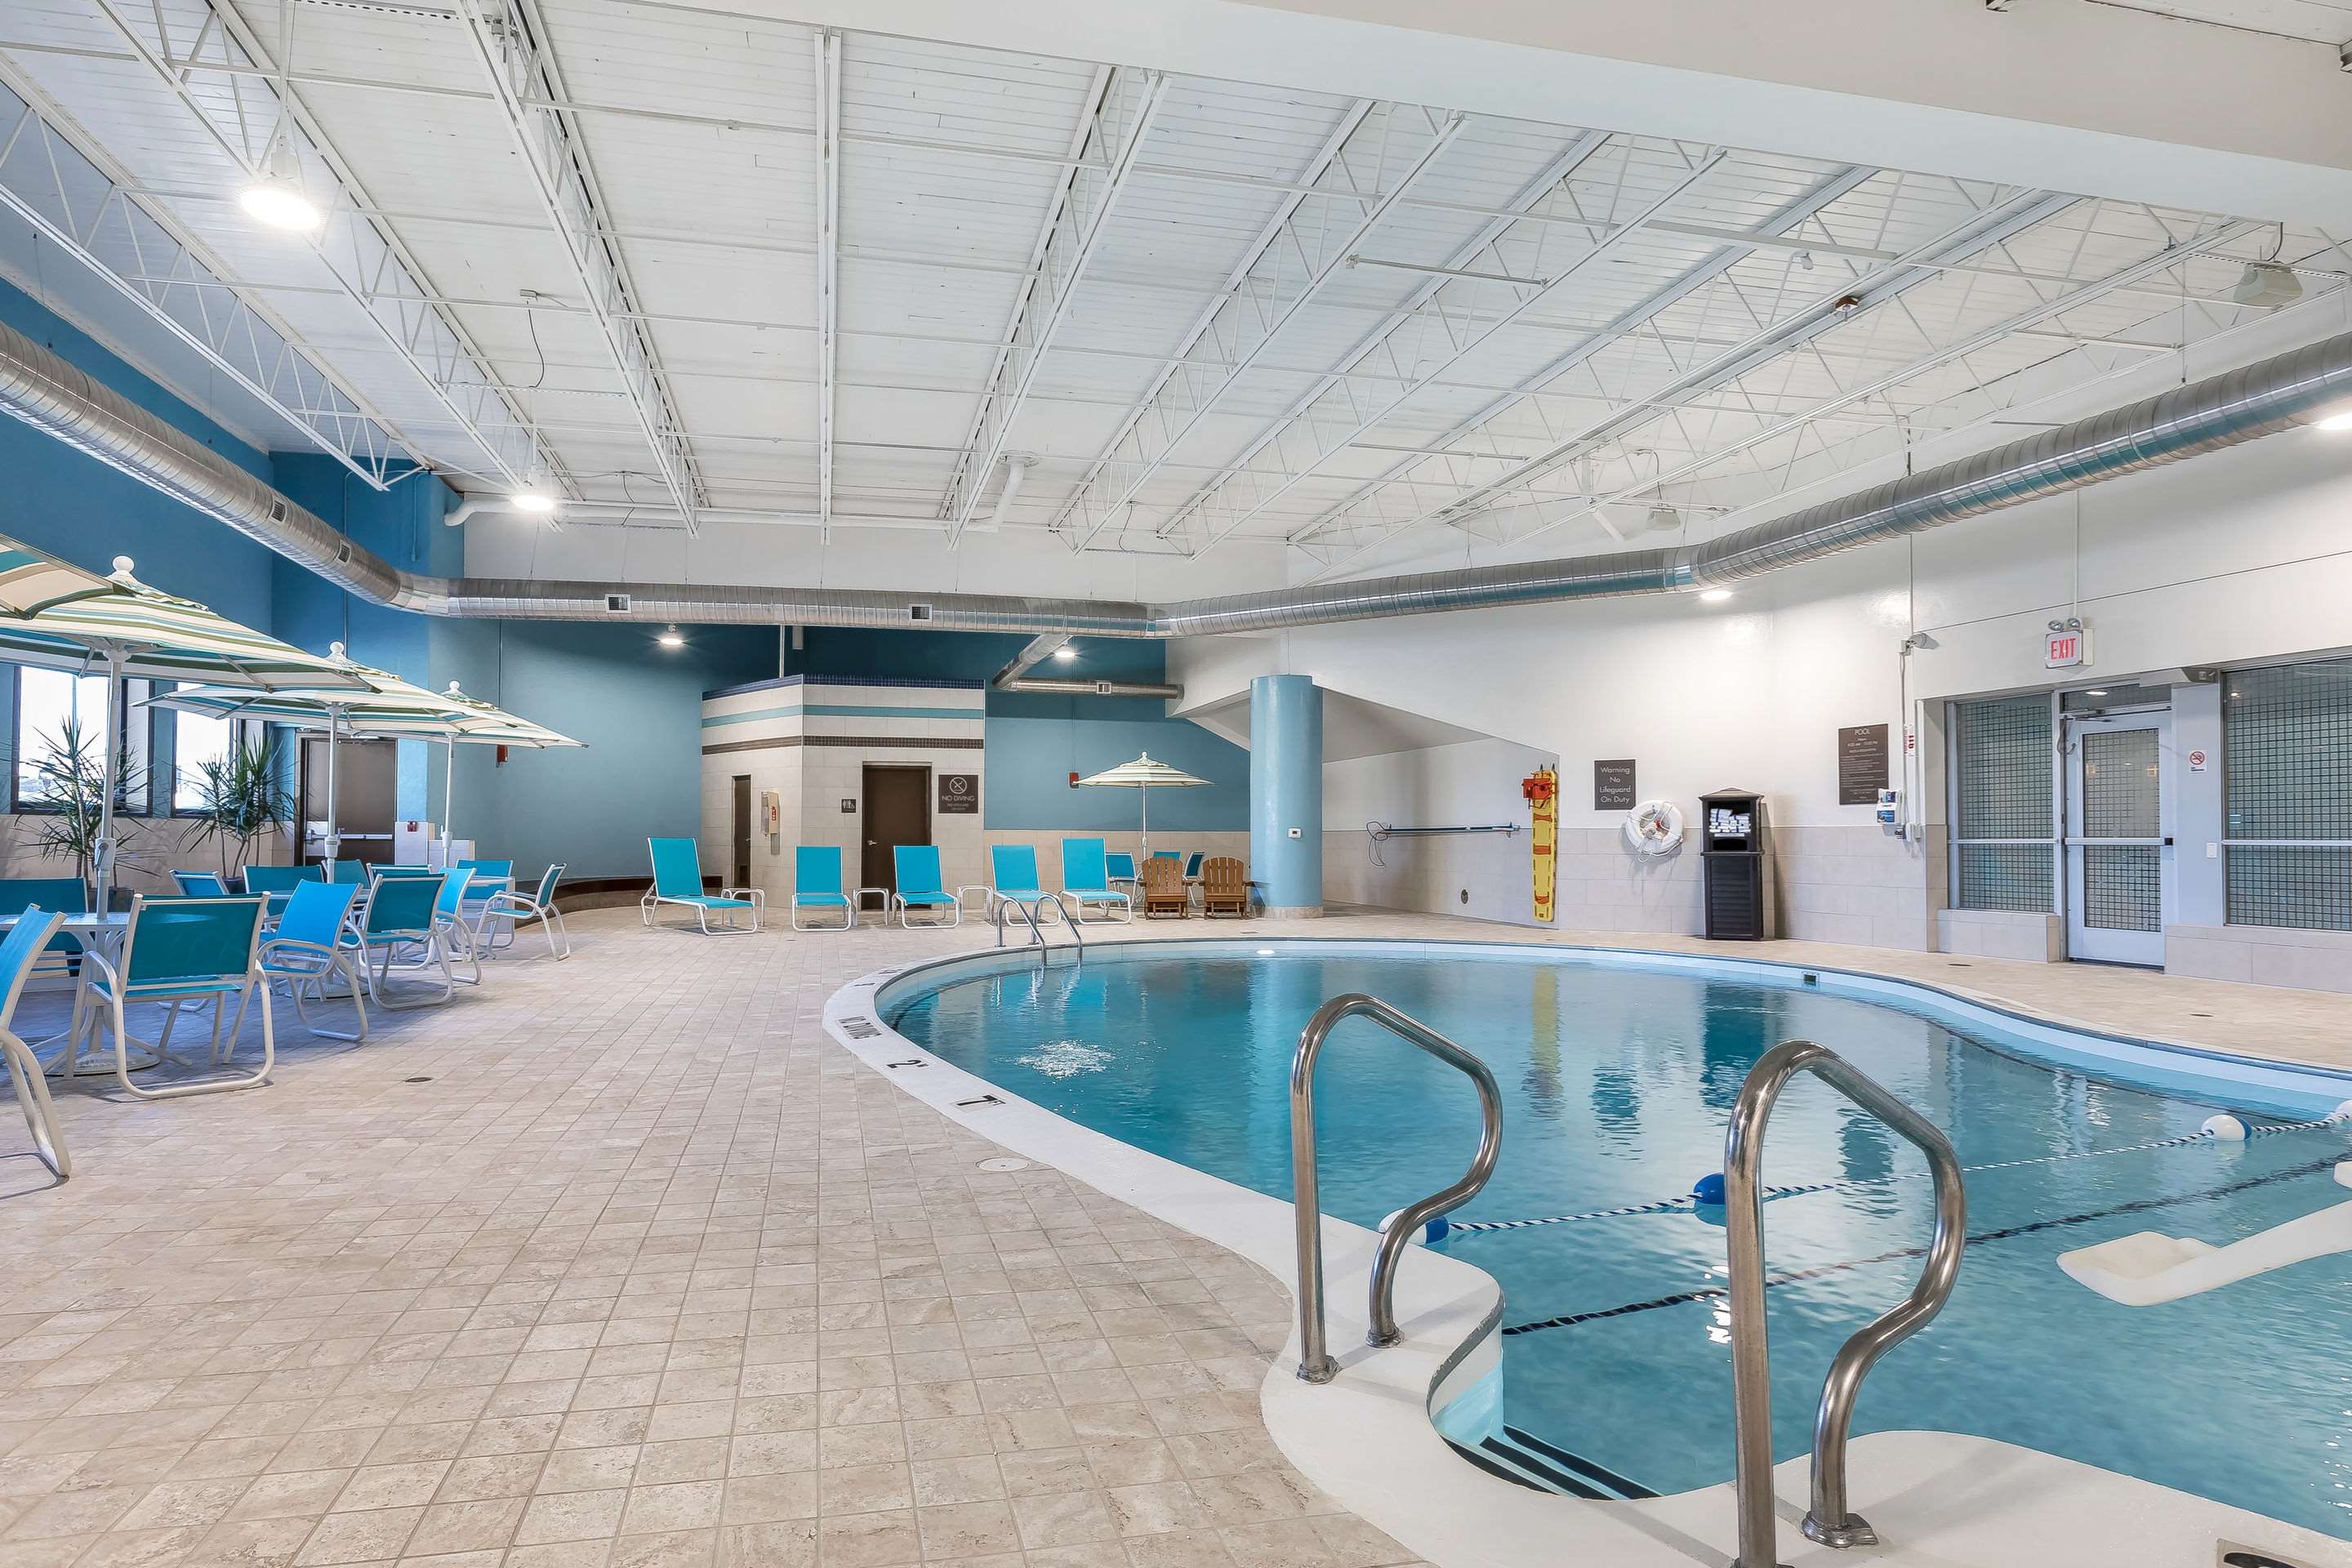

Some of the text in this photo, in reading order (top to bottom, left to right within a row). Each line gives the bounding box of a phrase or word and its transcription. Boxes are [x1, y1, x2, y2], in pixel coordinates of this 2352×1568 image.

[2051, 638, 2077, 661] EXIT
[1855, 728, 1870, 736] POOL
[1600, 766, 1630, 775] Warning
[1599, 785, 1632, 795] Lifeguard
[1614, 795, 1630, 804] Duty
